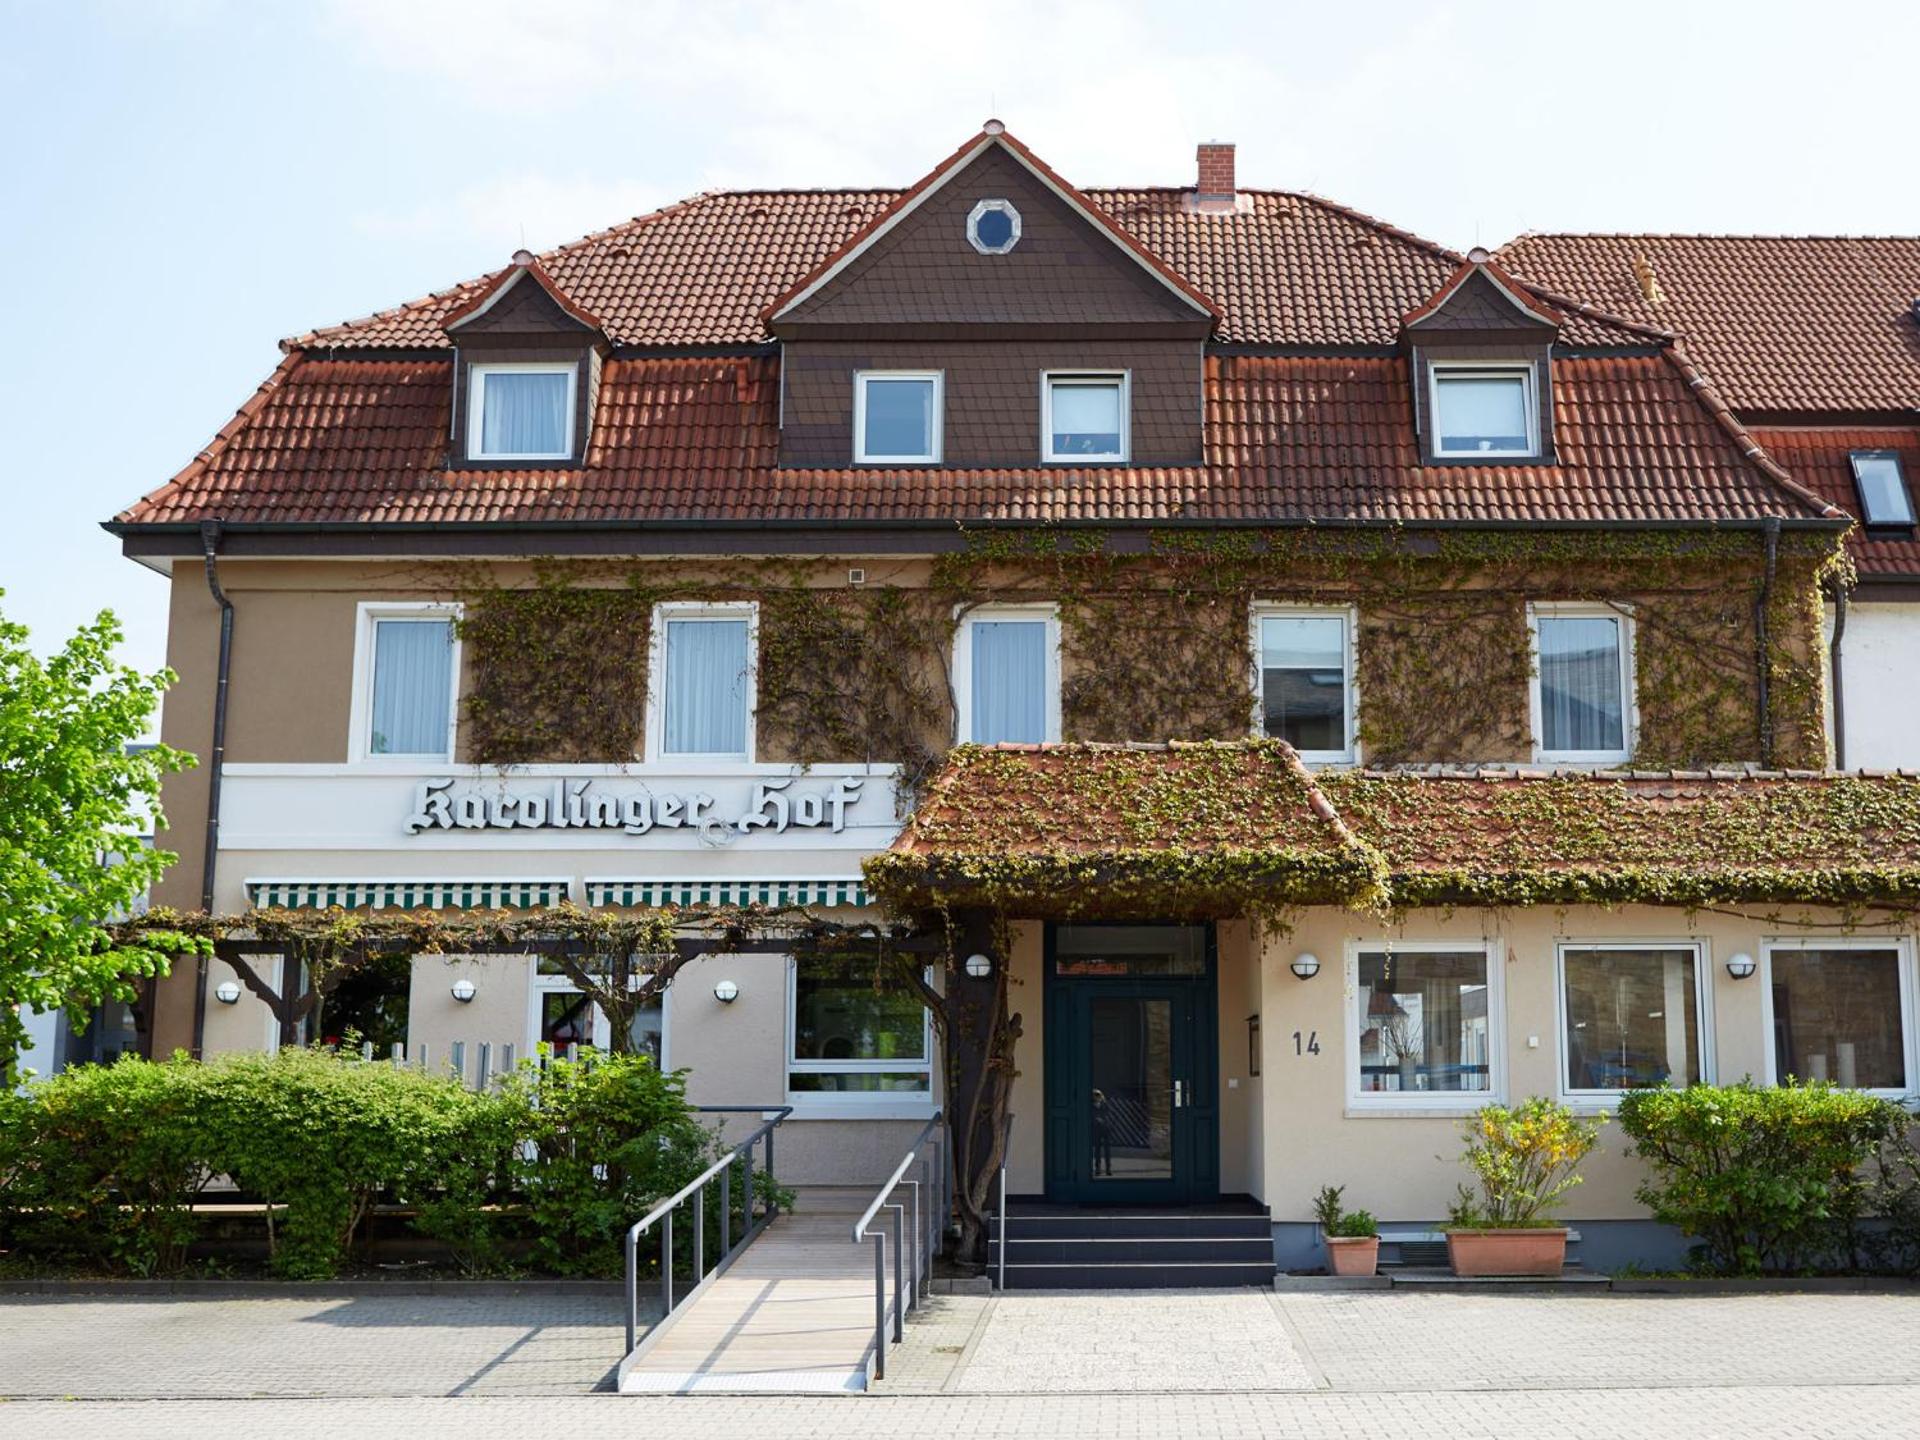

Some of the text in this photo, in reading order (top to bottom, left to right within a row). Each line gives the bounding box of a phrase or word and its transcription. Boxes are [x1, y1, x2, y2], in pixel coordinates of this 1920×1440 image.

[403, 776, 865, 835] Karolinger Hof
[1293, 1031, 1320, 1056] 14
